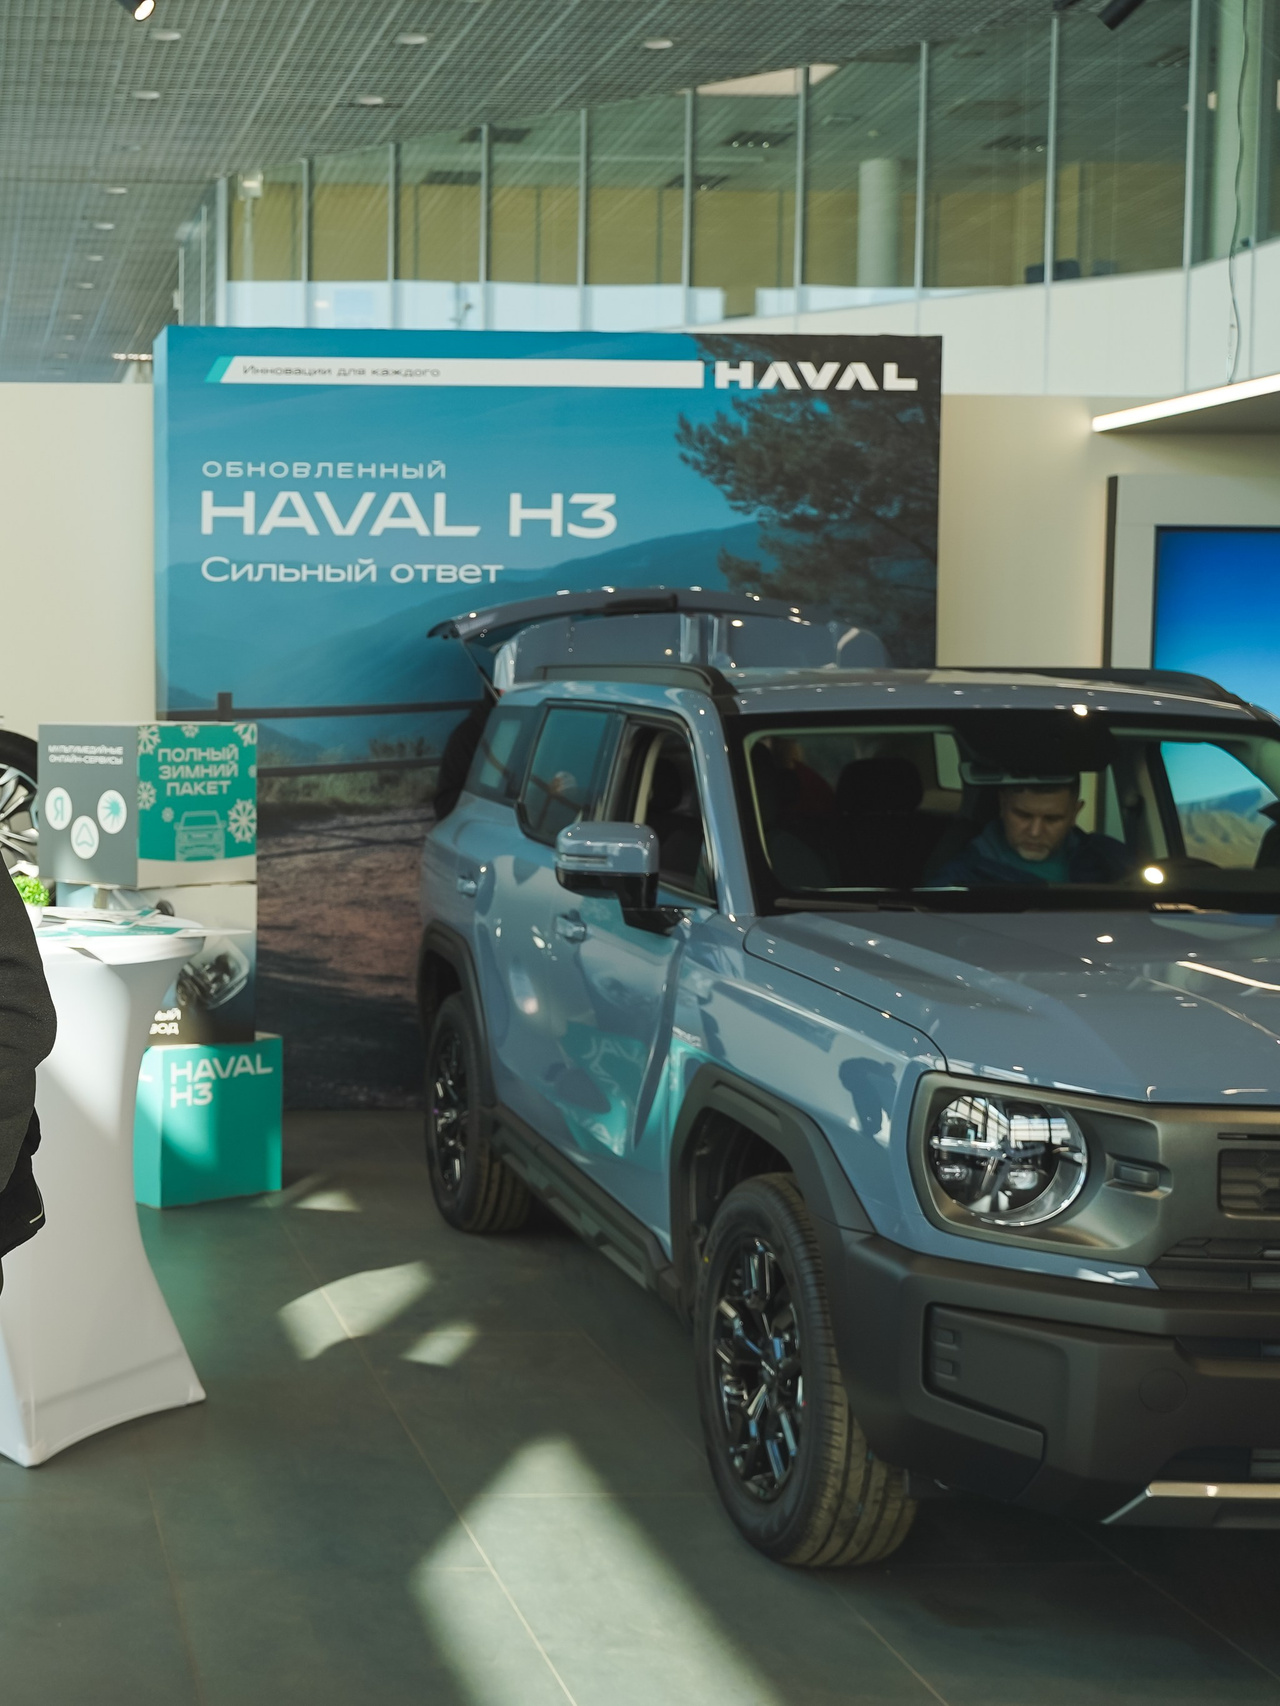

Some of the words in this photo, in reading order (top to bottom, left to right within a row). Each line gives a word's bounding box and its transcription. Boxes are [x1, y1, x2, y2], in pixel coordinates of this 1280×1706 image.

[242, 364, 332, 377] Инновации
[336, 367, 365, 378] для
[371, 368, 441, 378] каждого
[714, 360, 918, 391] HAVAL
[202, 461, 446, 480] ОБНОВЛЕННЫЙ
[201, 491, 480, 537] HAVAL
[509, 492, 618, 538] H3
[202, 555, 377, 583] Сильный
[390, 563, 505, 584] ответ
[157, 743, 239, 763] ПОЛНЫЙ
[158, 762, 239, 780] ЗИМНИЙ
[166, 780, 232, 796] ПАКЕТ
[170, 1053, 273, 1085] HAVAL
[170, 1081, 213, 1109] H3
